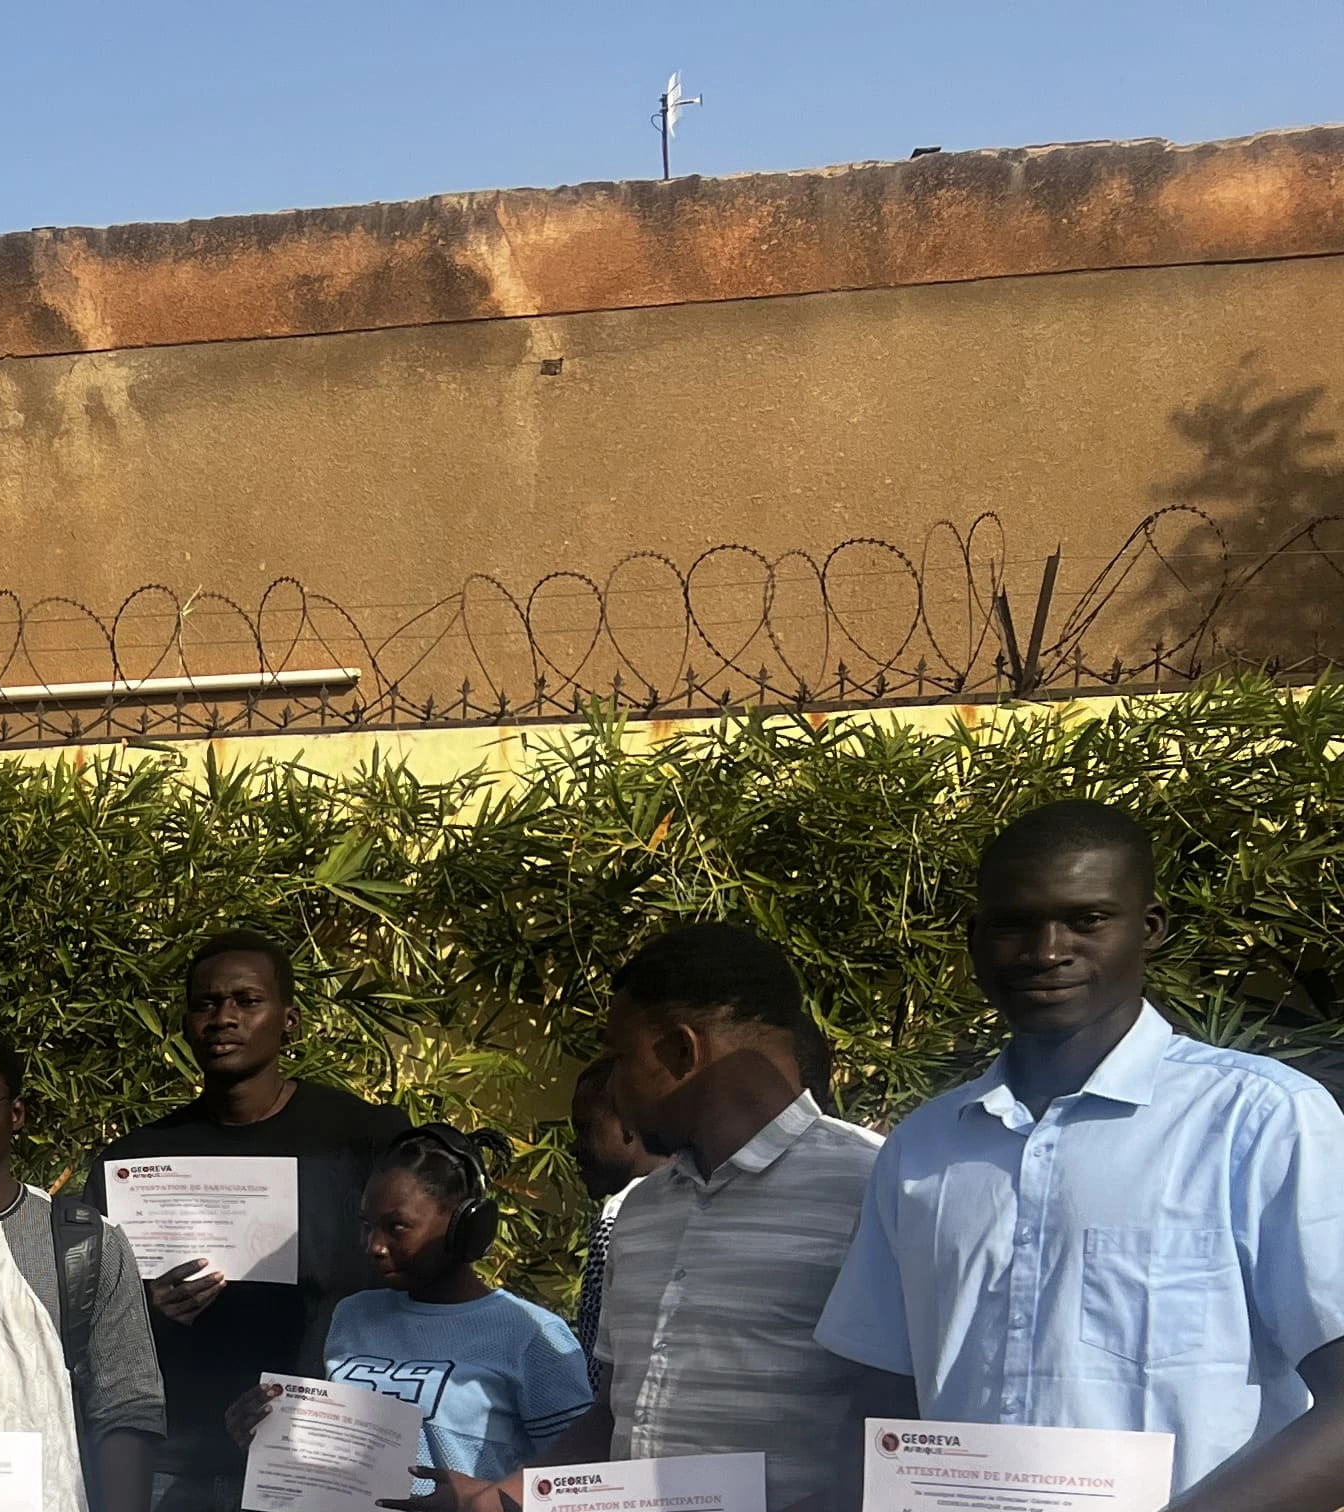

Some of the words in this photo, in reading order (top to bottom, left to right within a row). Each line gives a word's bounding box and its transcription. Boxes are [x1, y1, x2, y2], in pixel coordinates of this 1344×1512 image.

[130, 1165, 173, 1173] GEOREVA
[284, 1384, 329, 1398] GEOREVA
[901, 1433, 961, 1447] GEOREVA
[553, 1474, 602, 1488] GEOREVA
[896, 1465, 980, 1480] ATTESTATION
[984, 1470, 1001, 1482] DE
[1005, 1471, 1115, 1489] PARTICIPATION
[555, 1486, 588, 1495] AFRIQUE
[623, 1500, 637, 1510] DE
[640, 1494, 723, 1509] PARTICIPATION
